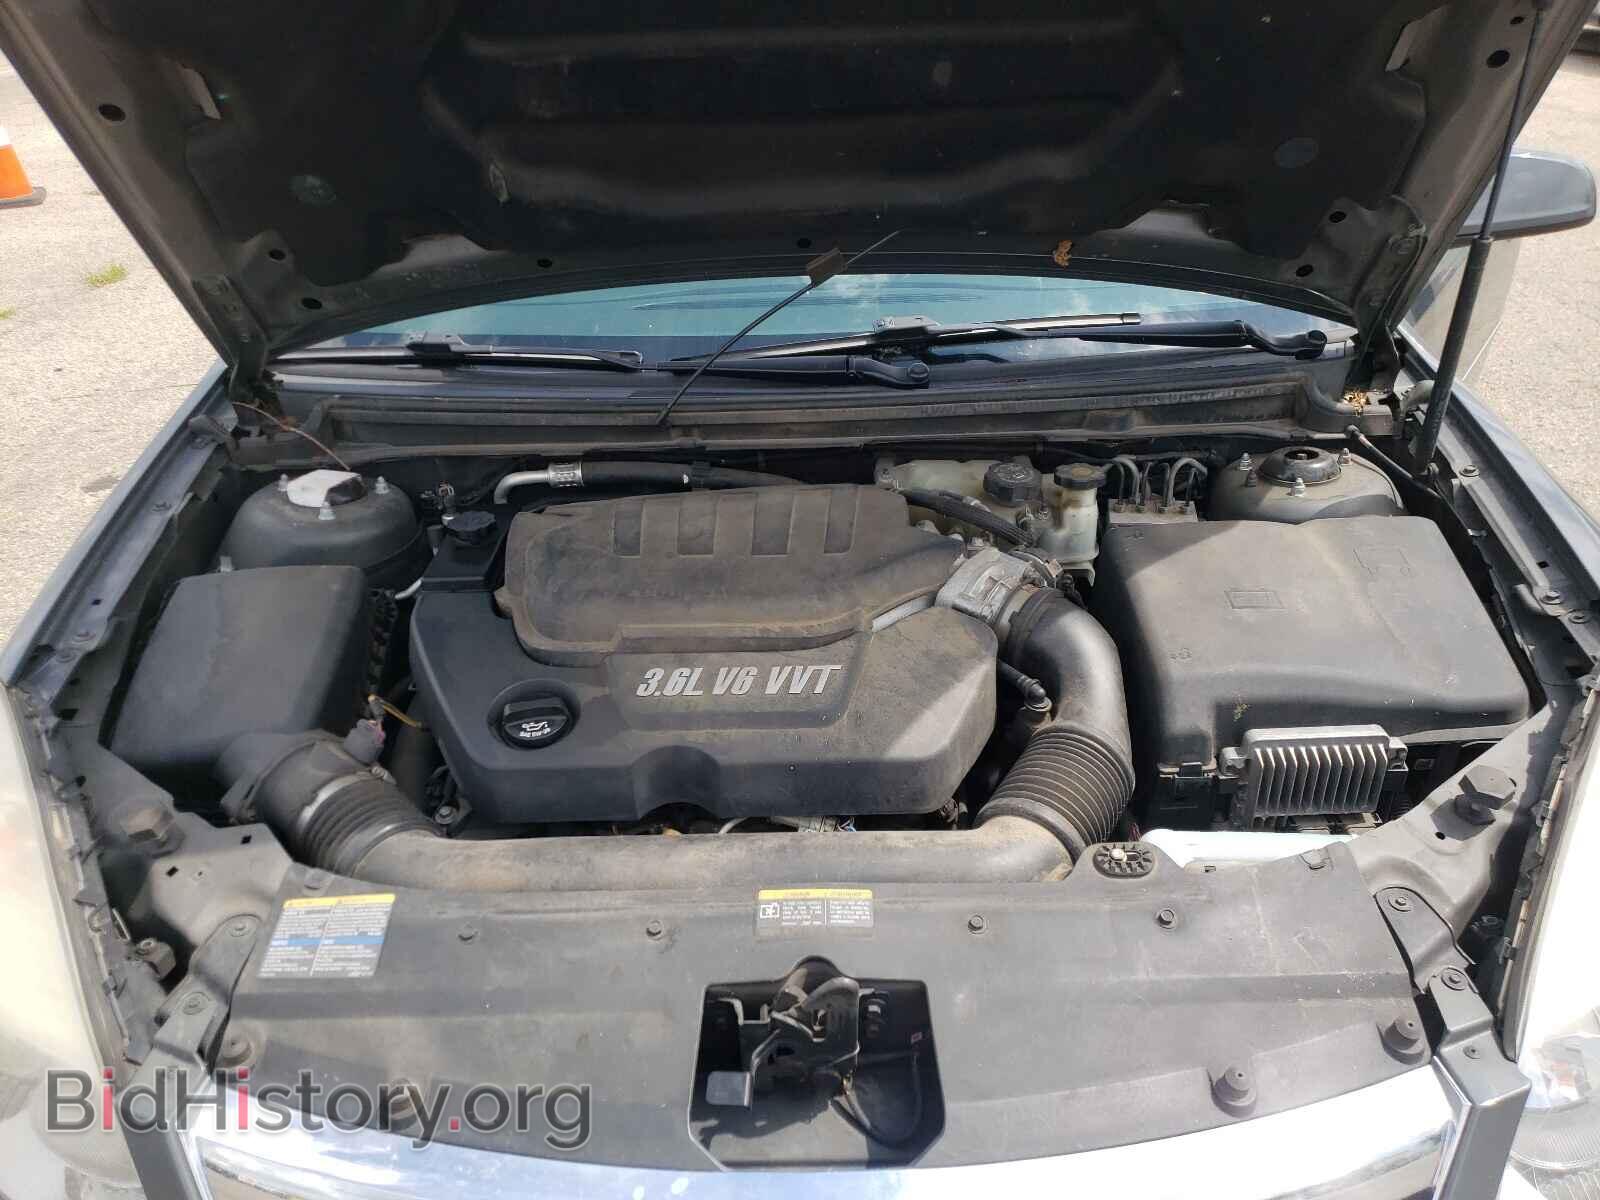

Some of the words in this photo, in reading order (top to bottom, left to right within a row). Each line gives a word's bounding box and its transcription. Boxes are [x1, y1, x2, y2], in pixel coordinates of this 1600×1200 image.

[636, 667, 704, 697] 3.6L
[712, 666, 758, 696] V6
[765, 665, 842, 695] VVT
